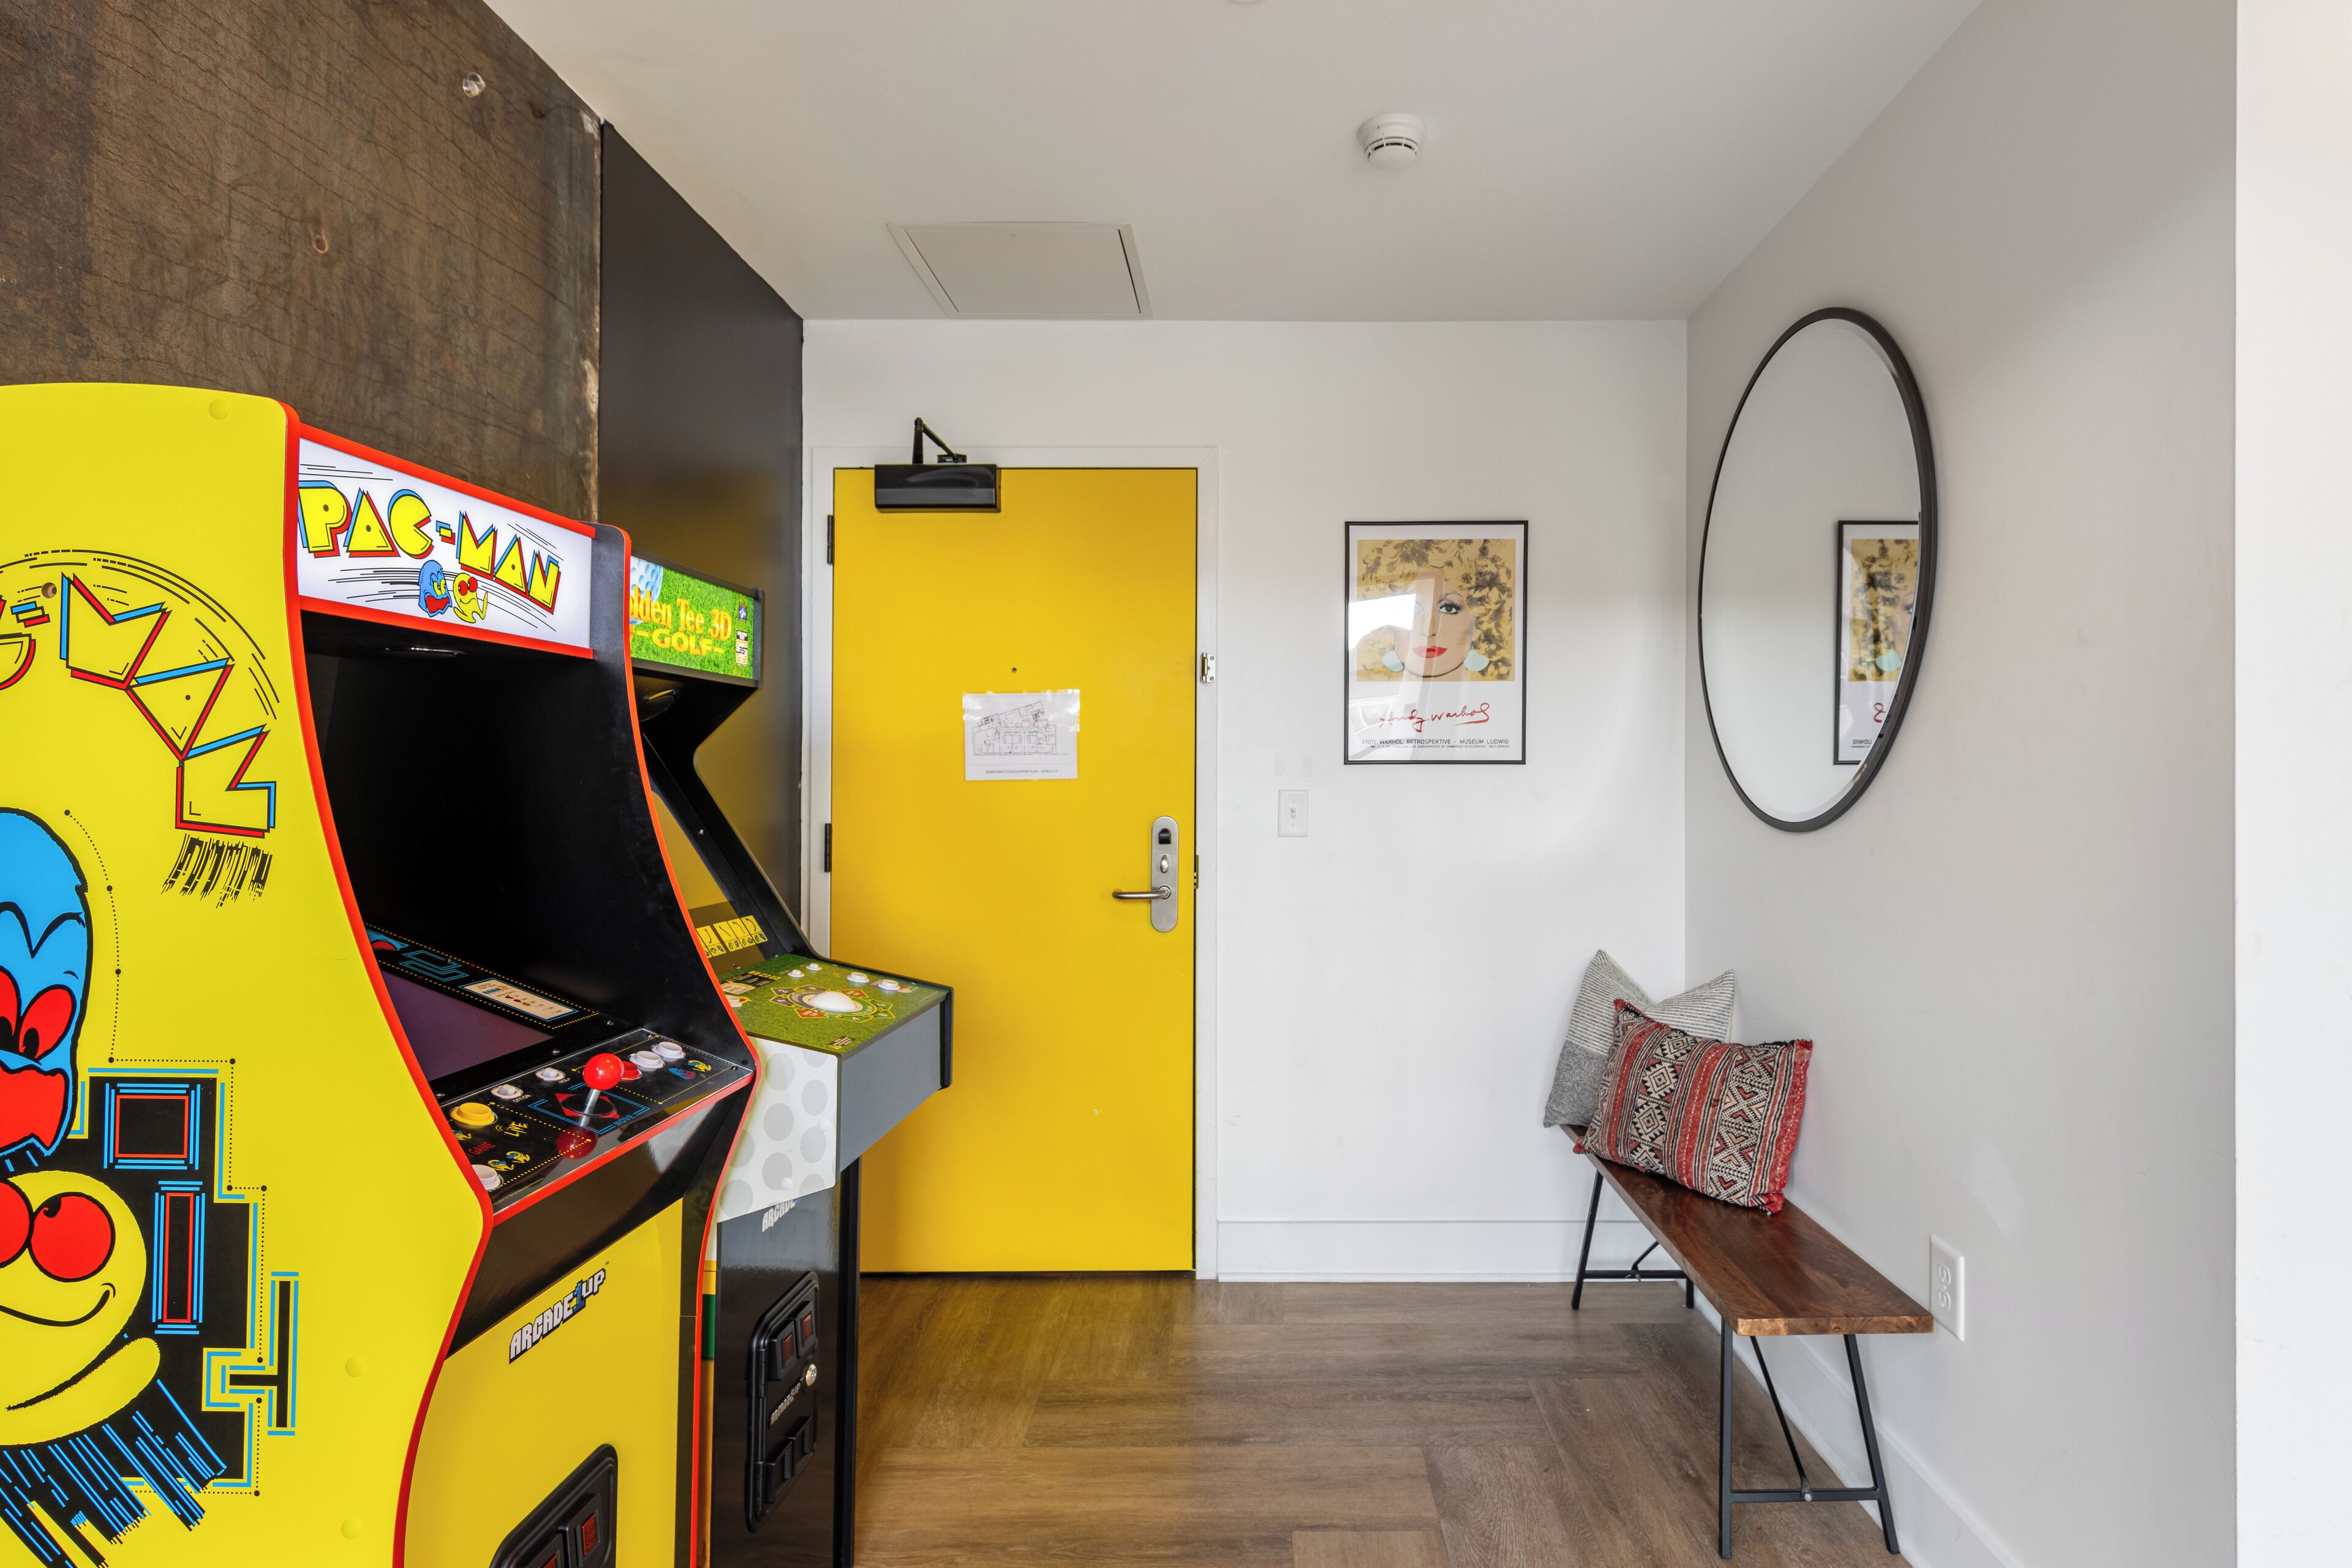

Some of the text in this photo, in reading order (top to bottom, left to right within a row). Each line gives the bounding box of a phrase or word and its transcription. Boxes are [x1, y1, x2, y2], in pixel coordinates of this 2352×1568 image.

[299, 480, 561, 614] PAC-MAN
[677, 598, 704, 635] Tee
[708, 609, 732, 641] 3D
[613, 1114, 636, 1126] MOVE
[468, 1141, 497, 1155] GAME
[509, 1268, 606, 1365] ARCADE1UP
